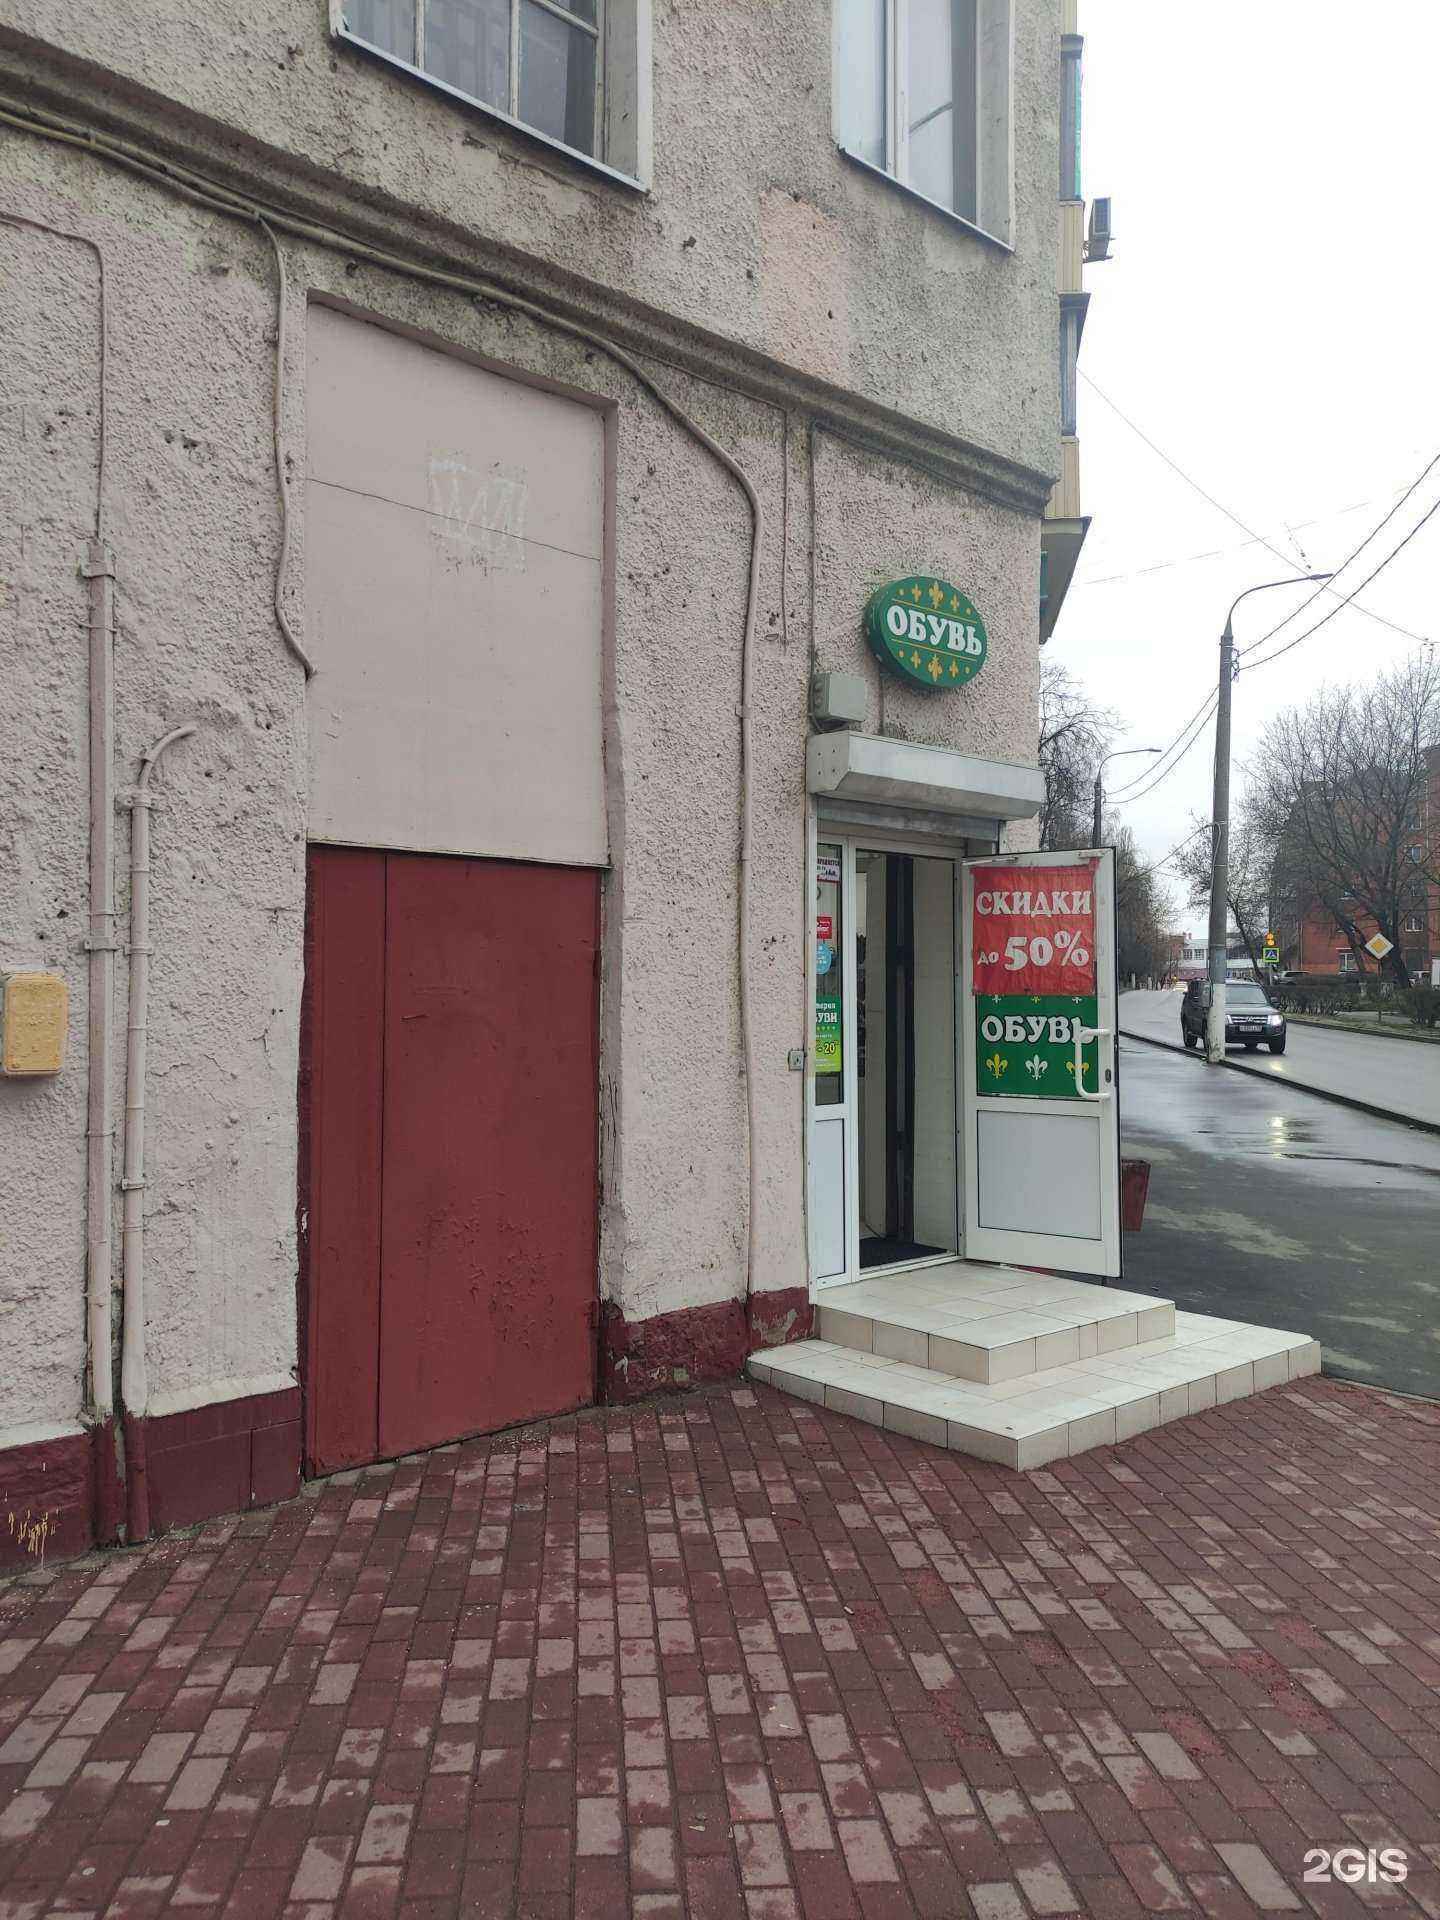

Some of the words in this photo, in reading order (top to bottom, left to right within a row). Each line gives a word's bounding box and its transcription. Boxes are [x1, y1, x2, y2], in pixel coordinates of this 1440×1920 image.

[887, 605, 982, 656] ОБУВЬ
[976, 891, 1092, 918] СКИДКИ
[1004, 931, 1090, 971] 50%
[816, 1012, 838, 1023] УВИ
[981, 1015, 1095, 1044] ОБУВЬ
